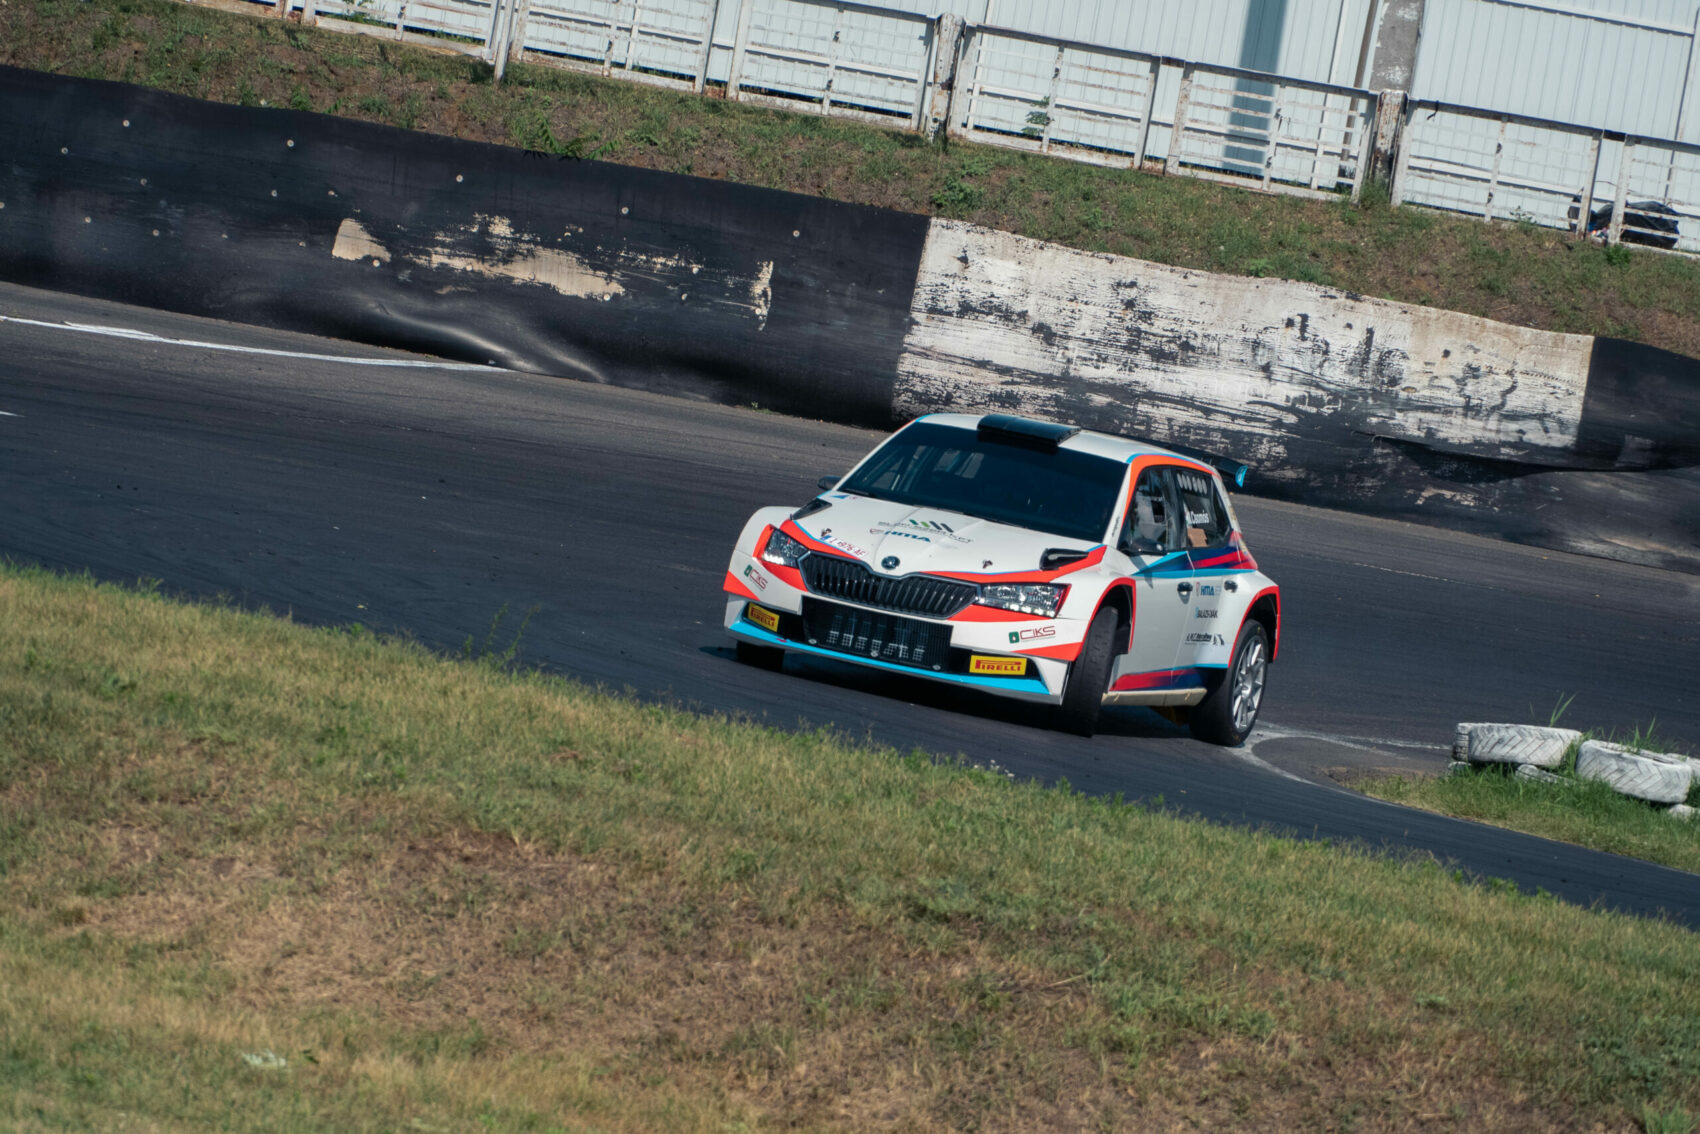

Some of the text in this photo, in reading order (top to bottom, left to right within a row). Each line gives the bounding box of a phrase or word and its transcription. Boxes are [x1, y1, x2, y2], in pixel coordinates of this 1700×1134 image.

[751, 607, 775, 627] PIRELLI
[1019, 626, 1056, 640] CIKS
[976, 660, 1020, 671] PIRELLI
